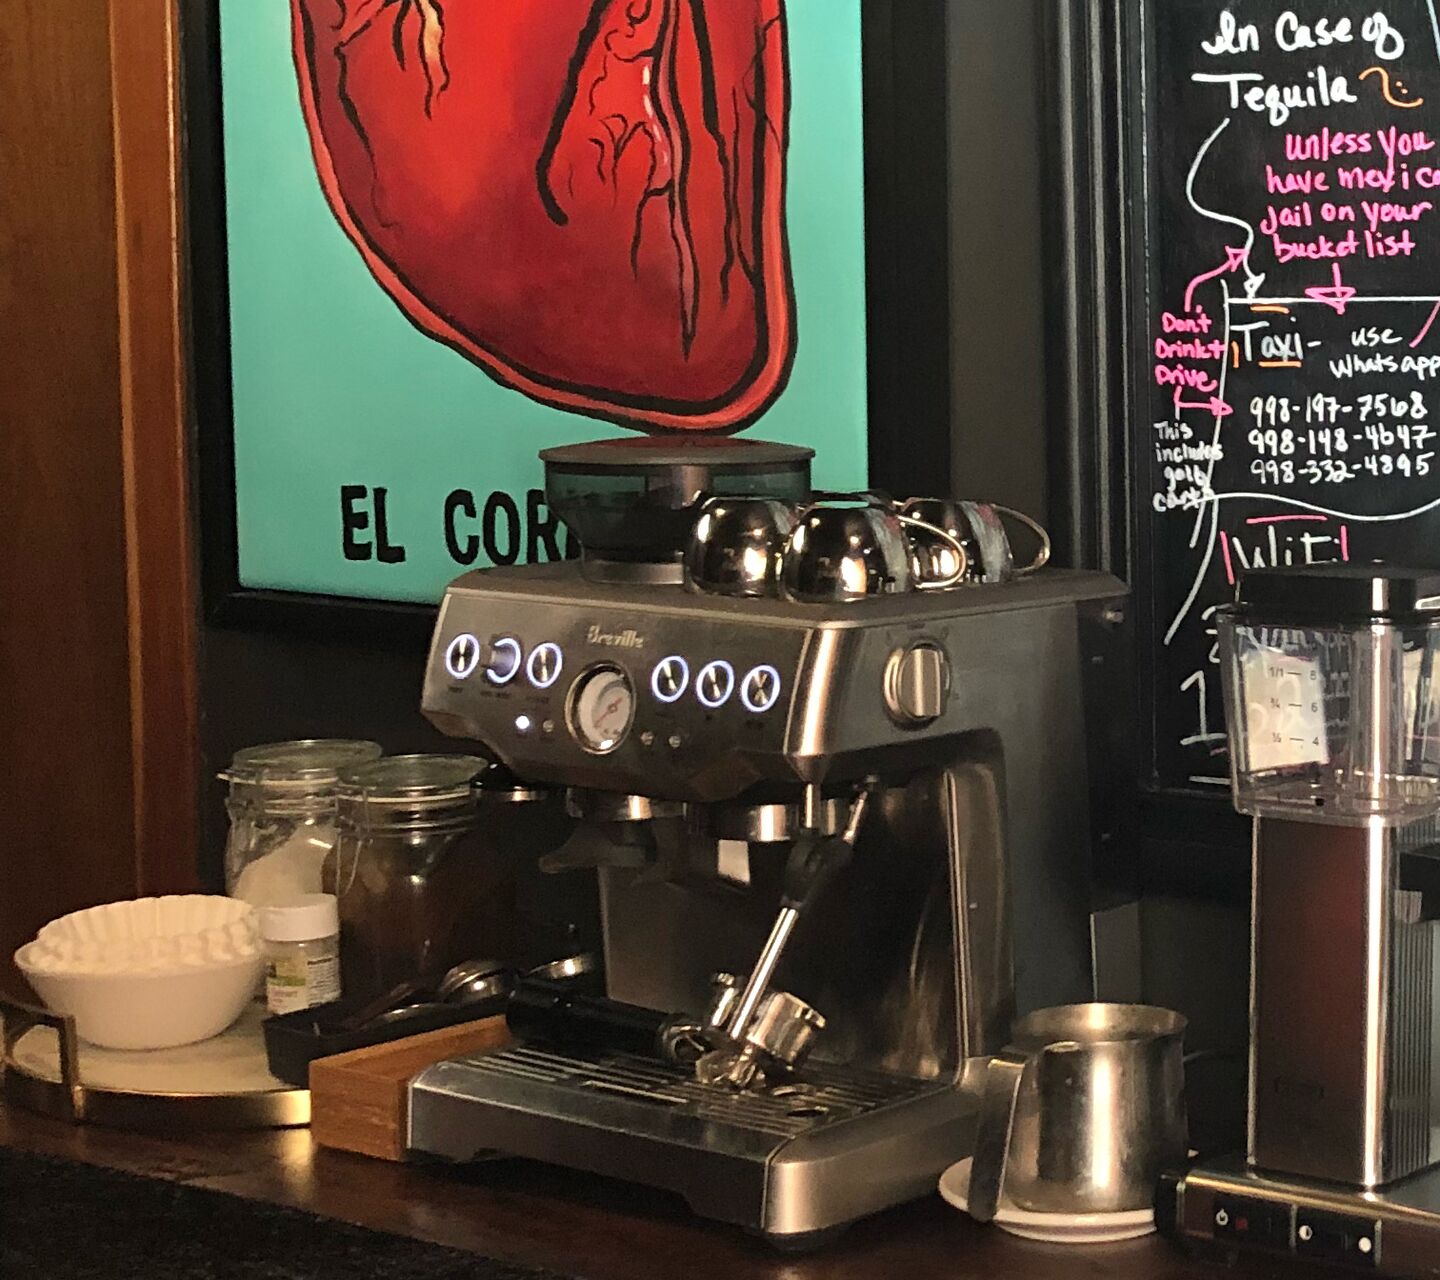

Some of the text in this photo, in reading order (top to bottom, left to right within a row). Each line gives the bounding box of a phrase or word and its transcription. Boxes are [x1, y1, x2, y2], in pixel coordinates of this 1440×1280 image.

[1201, 9, 1259, 56] In
[1191, 65, 1358, 127] Tequila
[1285, 127, 1371, 161] unless
[1265, 163, 1330, 195] have
[1321, 203, 1356, 223] on
[1361, 203, 1432, 232] your
[1365, 228, 1416, 258] list
[1351, 328, 1403, 346] use
[1155, 364, 1218, 392] Drive
[1249, 394, 1428, 426] 998-197-7568
[1153, 420, 1193, 441] This
[1248, 423, 1436, 456] 998-148-4647
[341, 485, 406, 563] EL
